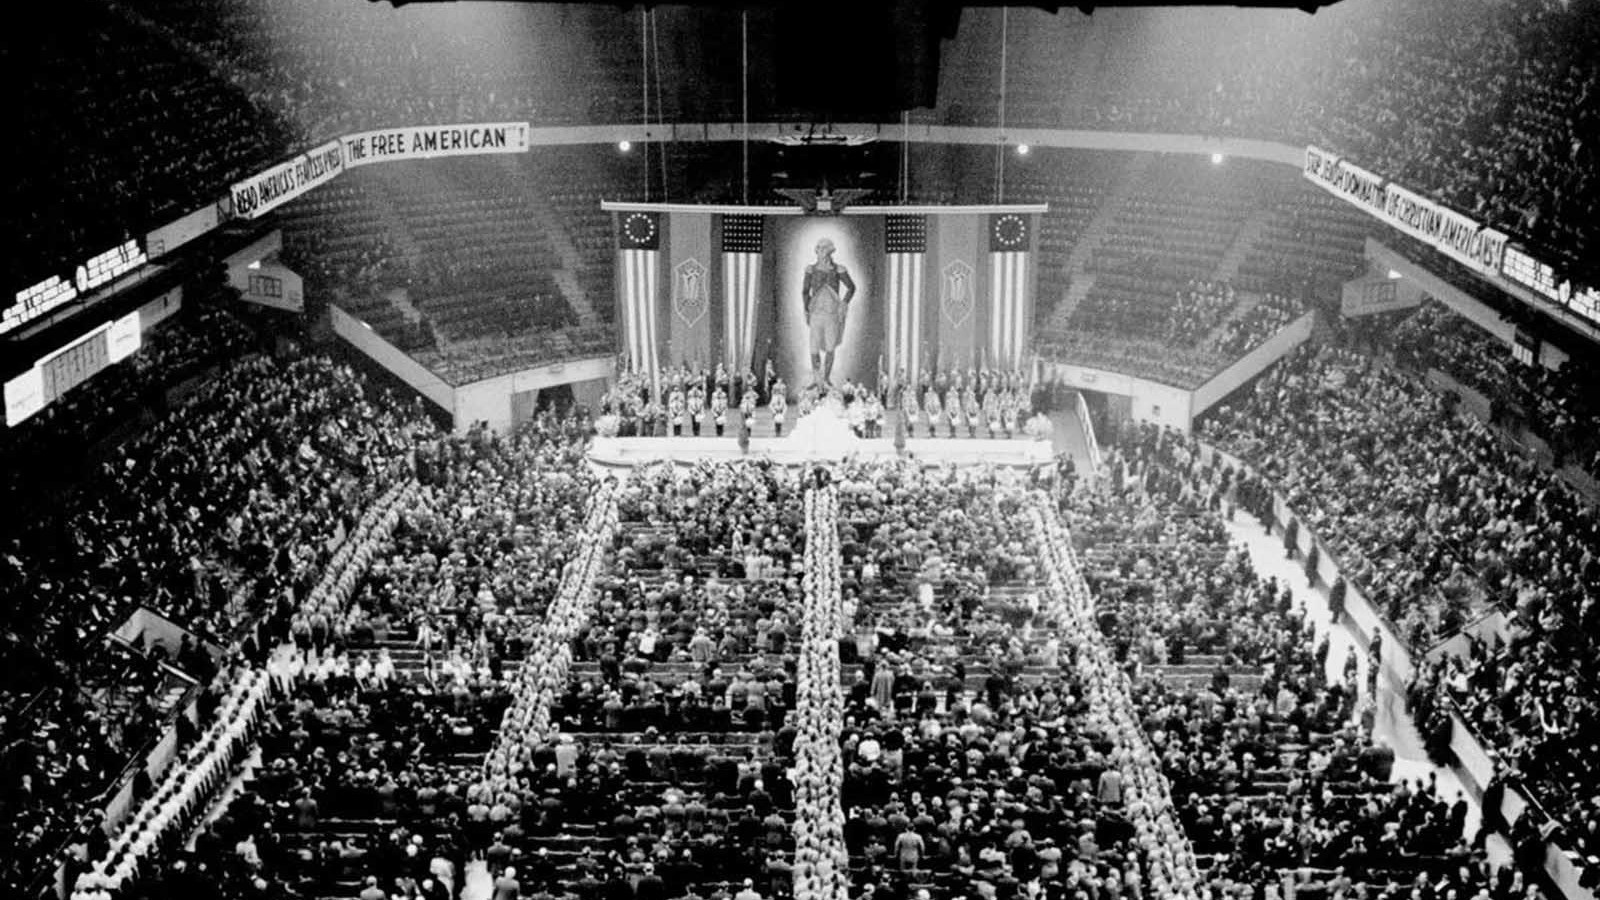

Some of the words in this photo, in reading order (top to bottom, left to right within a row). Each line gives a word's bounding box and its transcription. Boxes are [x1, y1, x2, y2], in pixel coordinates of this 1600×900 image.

[348, 137, 366, 162] THE
[371, 133, 405, 156] FREE
[412, 127, 506, 152] AMERICAN
